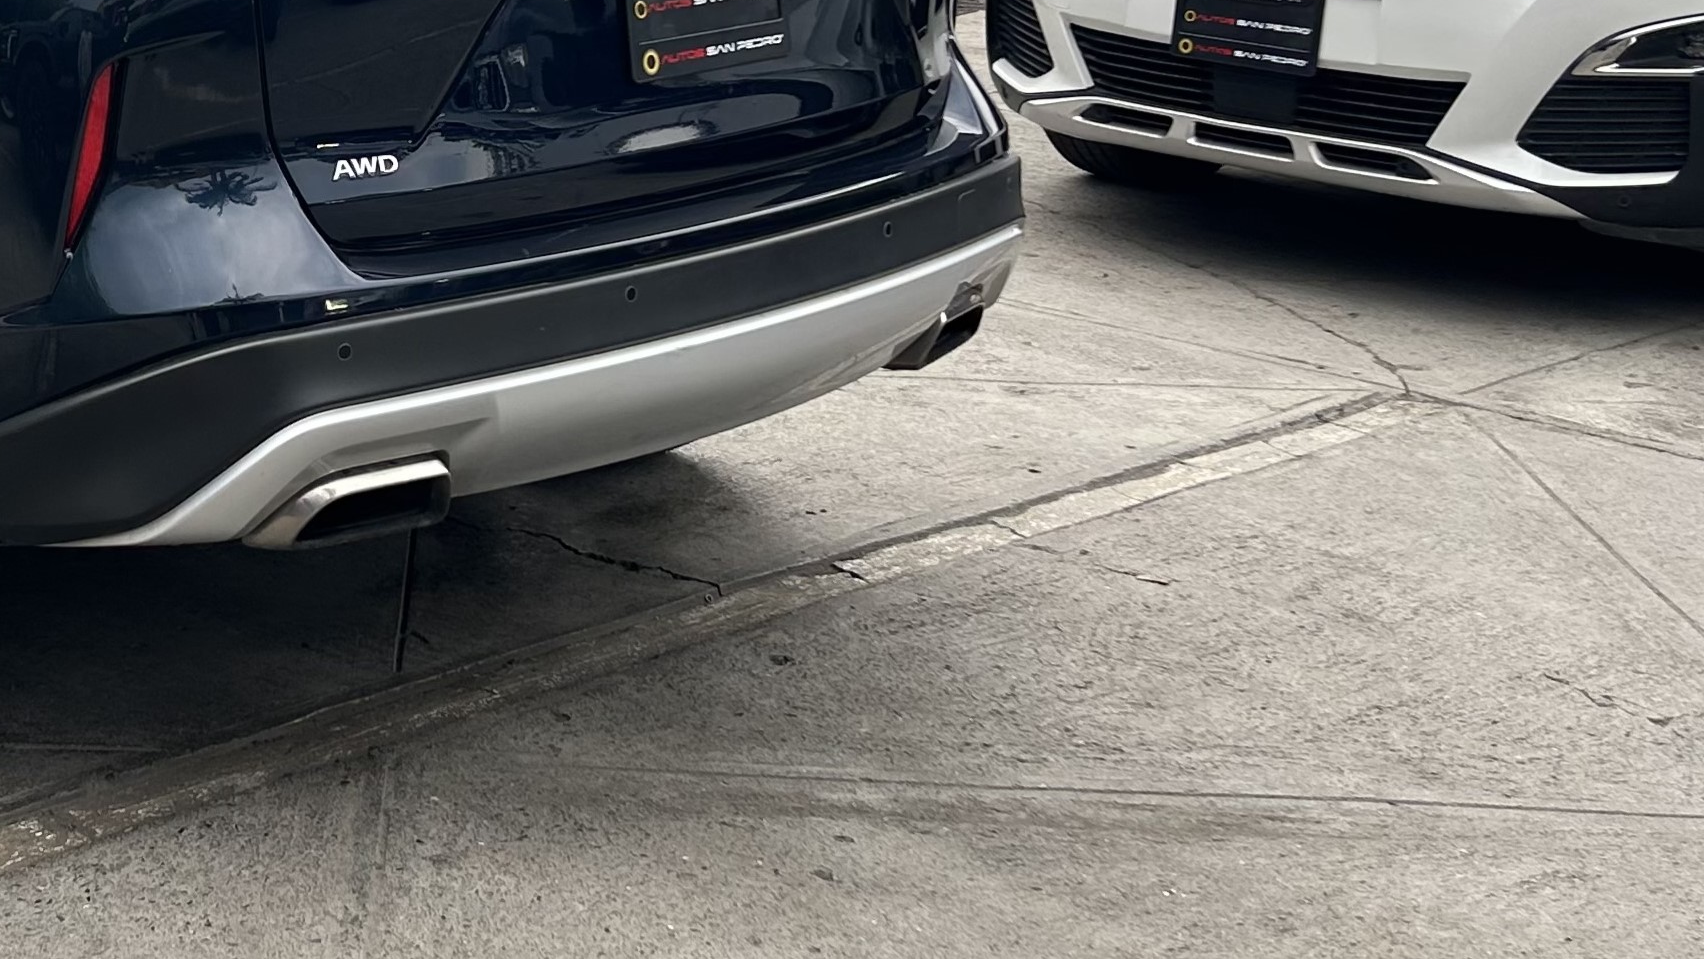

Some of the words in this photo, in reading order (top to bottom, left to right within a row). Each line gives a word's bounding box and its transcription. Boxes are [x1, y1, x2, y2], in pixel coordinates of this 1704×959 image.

[660, 48, 706, 64] AUTOS
[706, 42, 736, 56] SAN
[736, 34, 784, 50] PEDRO
[332, 154, 399, 181] AWD
